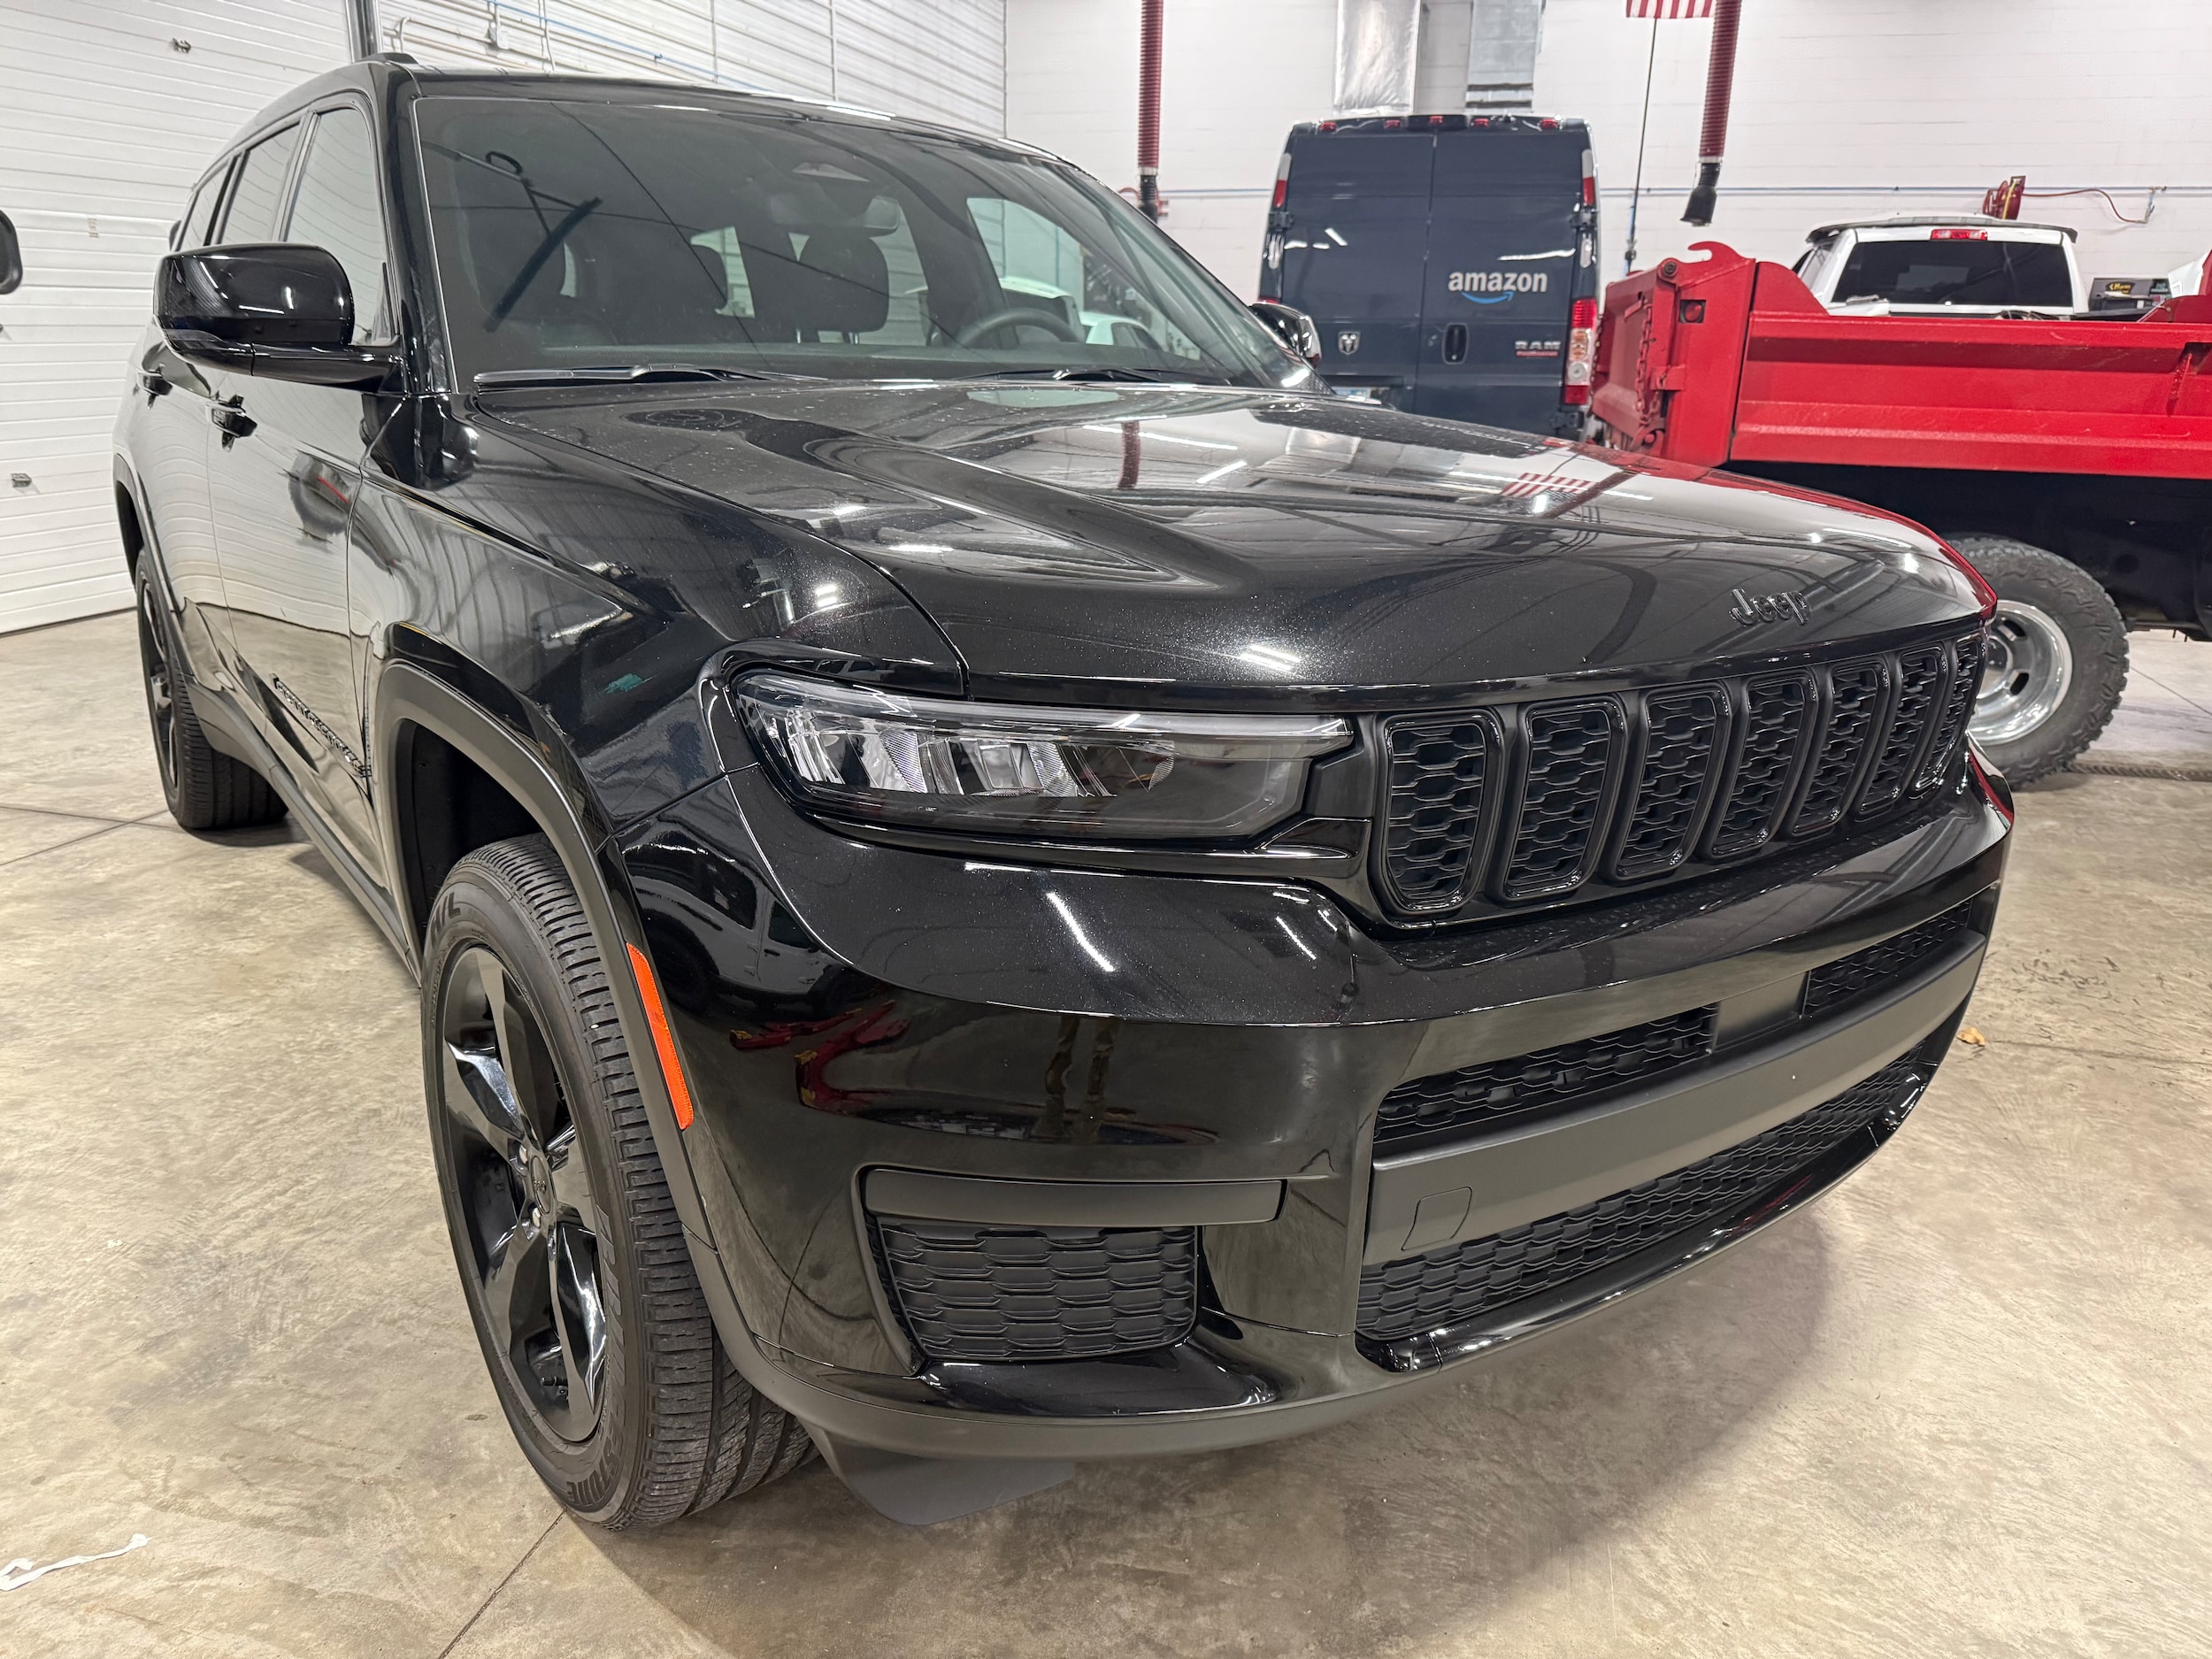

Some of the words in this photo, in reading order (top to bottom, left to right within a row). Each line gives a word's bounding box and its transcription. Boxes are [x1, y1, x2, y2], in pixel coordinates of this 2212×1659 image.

[1448, 271, 1548, 293] amazon
[1515, 341, 1561, 350] RAM
[1728, 588, 1809, 625] Jeep
